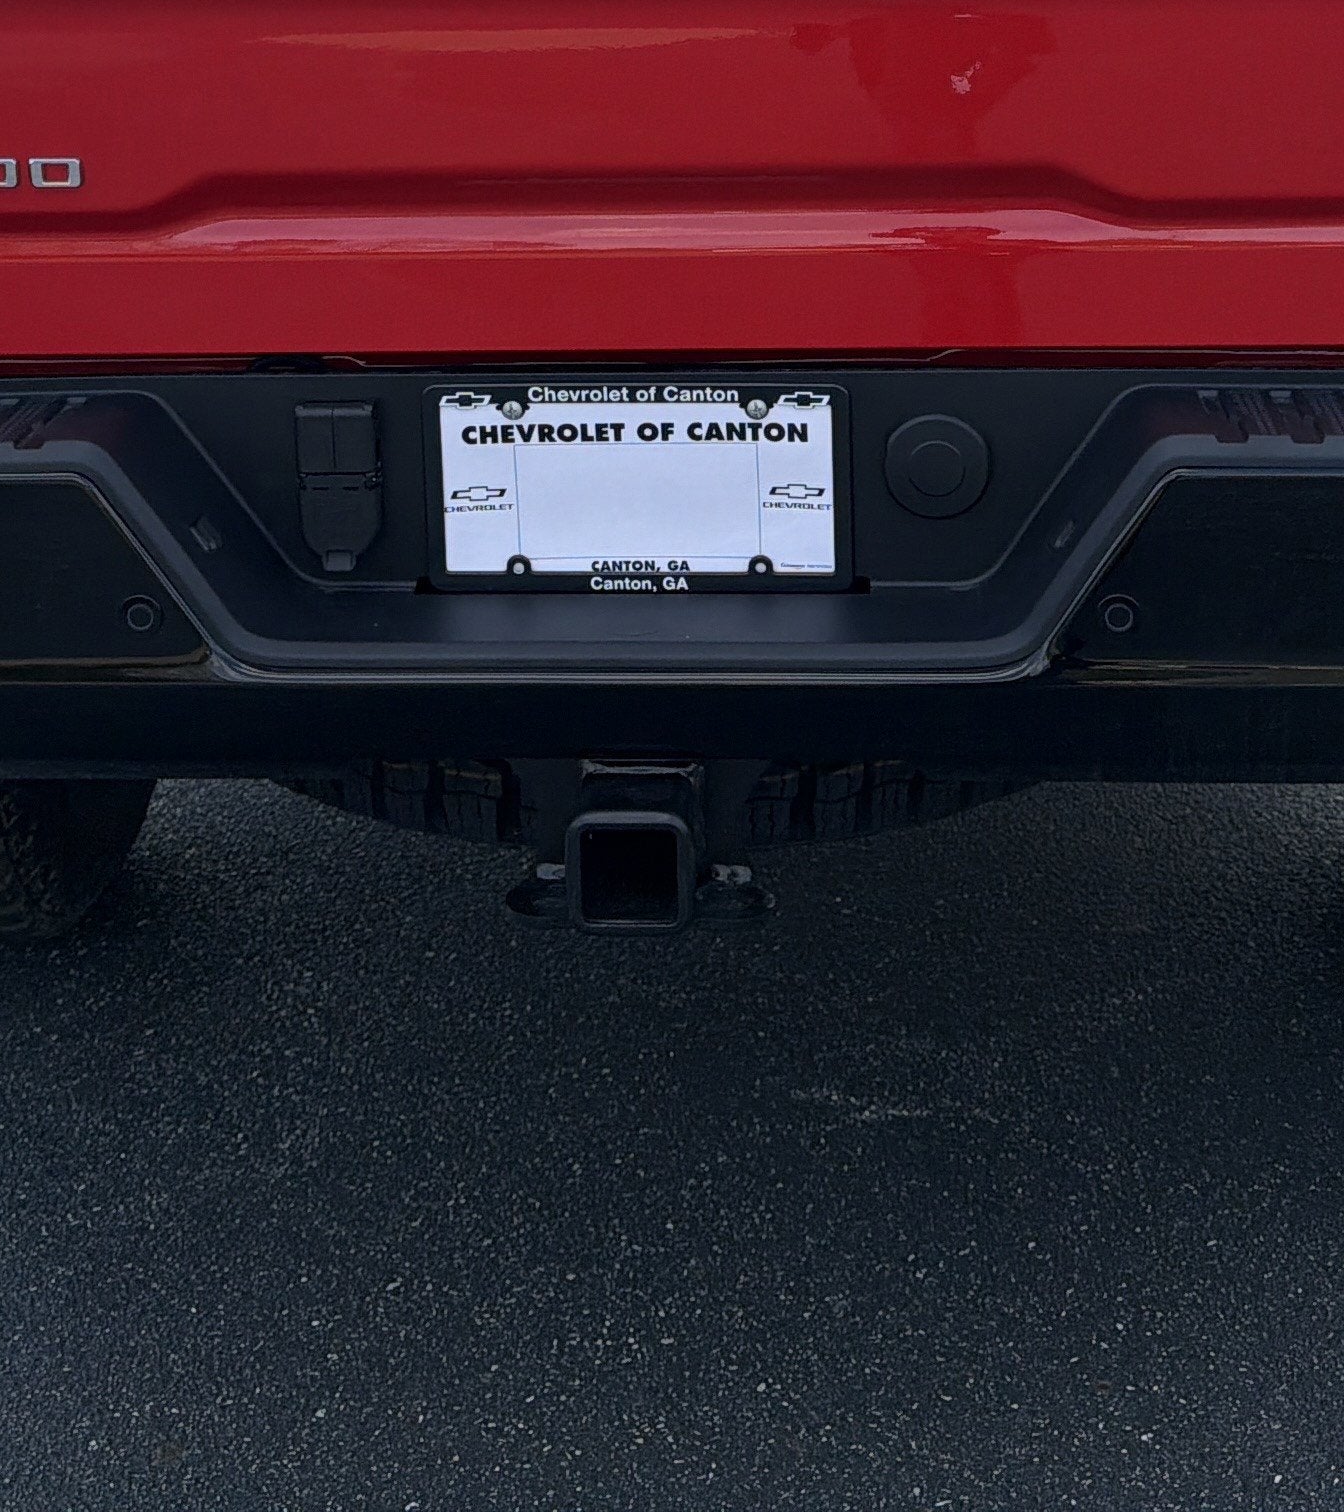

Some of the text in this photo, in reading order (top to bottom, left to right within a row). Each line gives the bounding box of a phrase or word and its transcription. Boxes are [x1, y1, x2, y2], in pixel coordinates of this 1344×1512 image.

[527, 386, 739, 402] Chevrolet of Canton
[461, 422, 809, 445] CHEVROLET OF CANTON
[444, 504, 514, 513] CHEVROLET
[763, 502, 832, 510] CHEVROLET
[591, 560, 690, 572] CANTON, GA
[590, 576, 689, 592] Canton, GA
